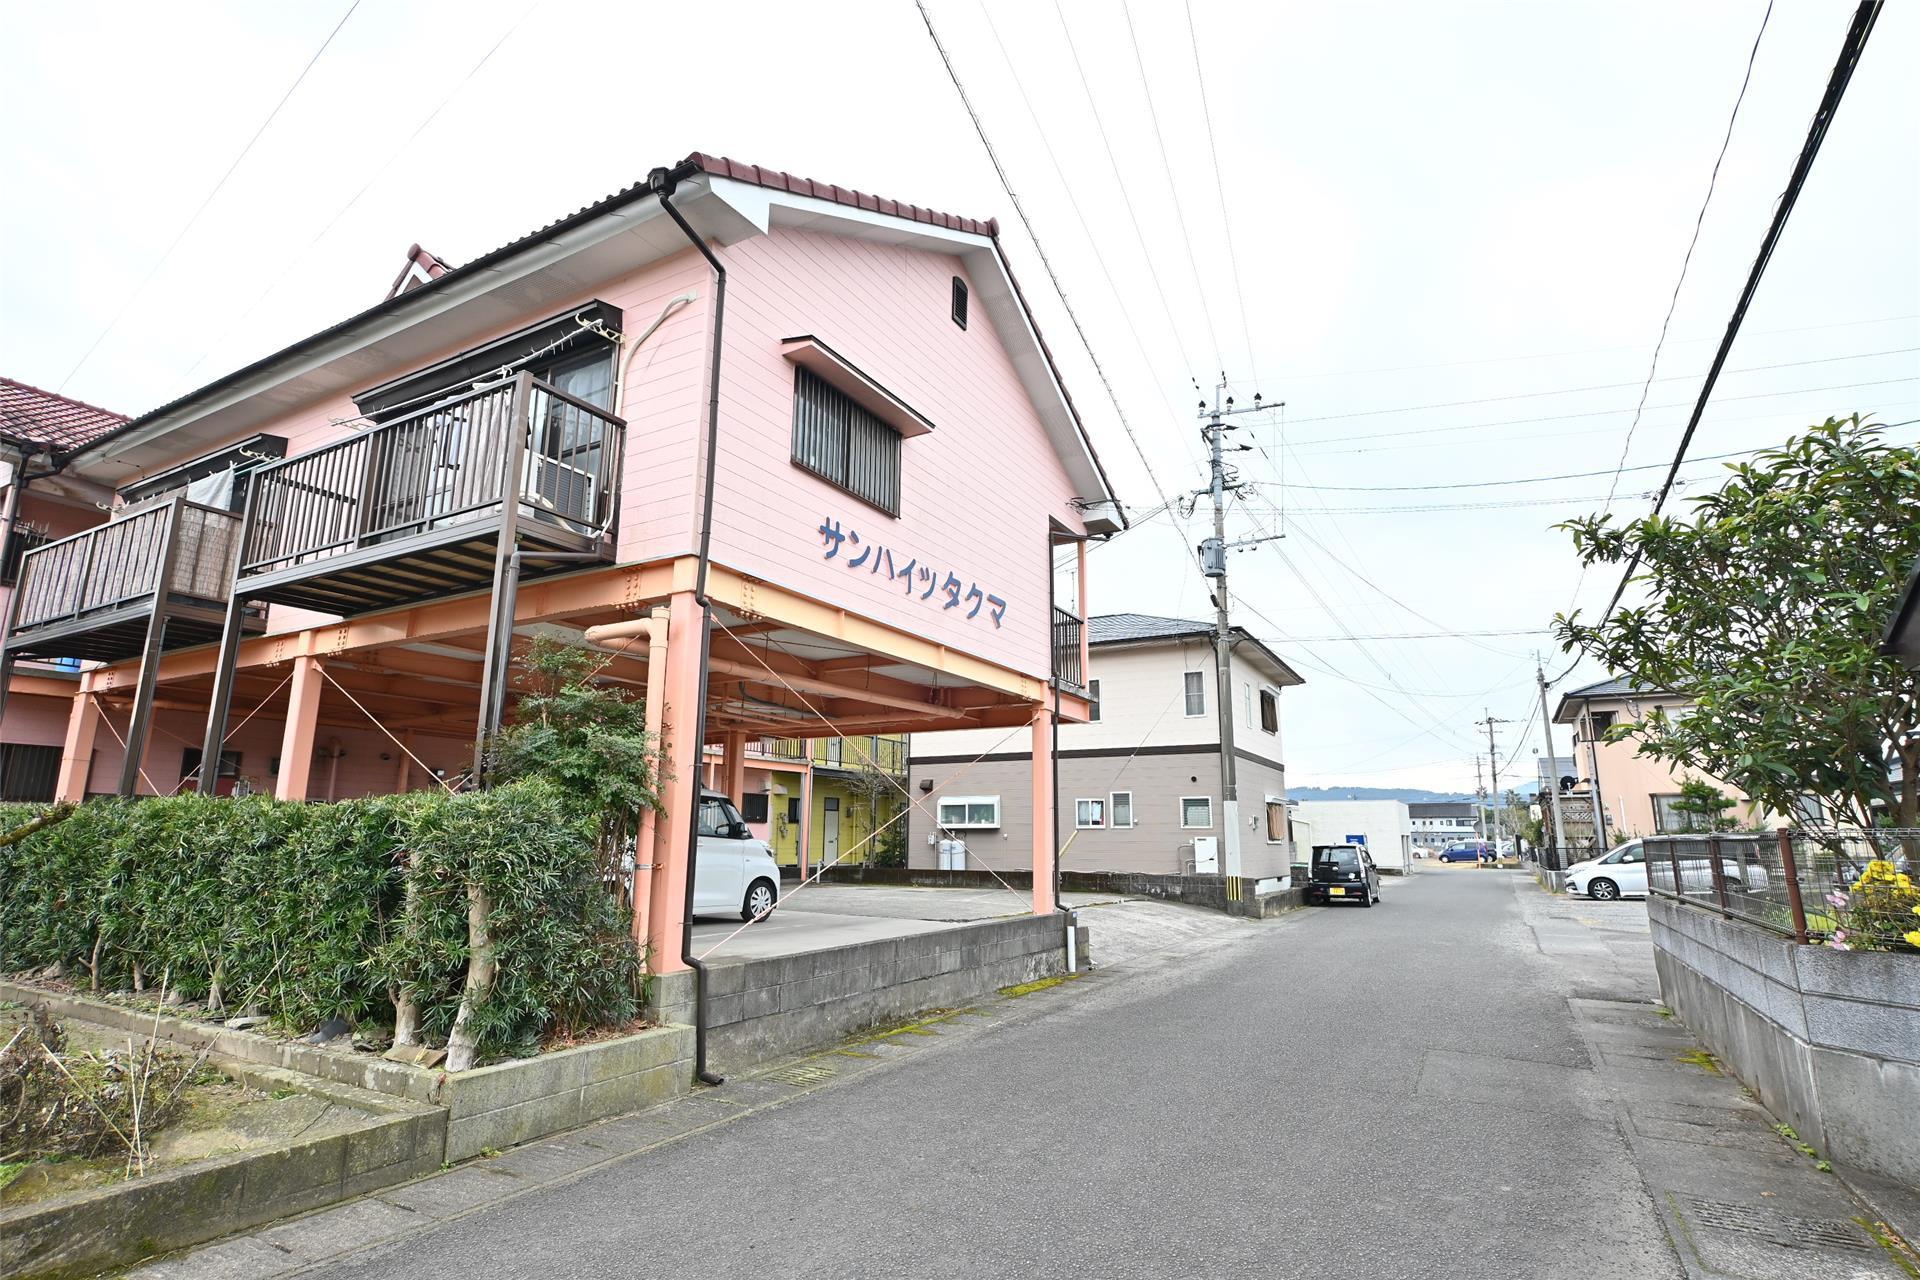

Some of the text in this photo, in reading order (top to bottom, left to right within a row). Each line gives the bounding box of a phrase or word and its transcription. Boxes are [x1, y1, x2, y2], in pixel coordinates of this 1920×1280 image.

[819, 517, 1006, 629] サンハイツタクマ
